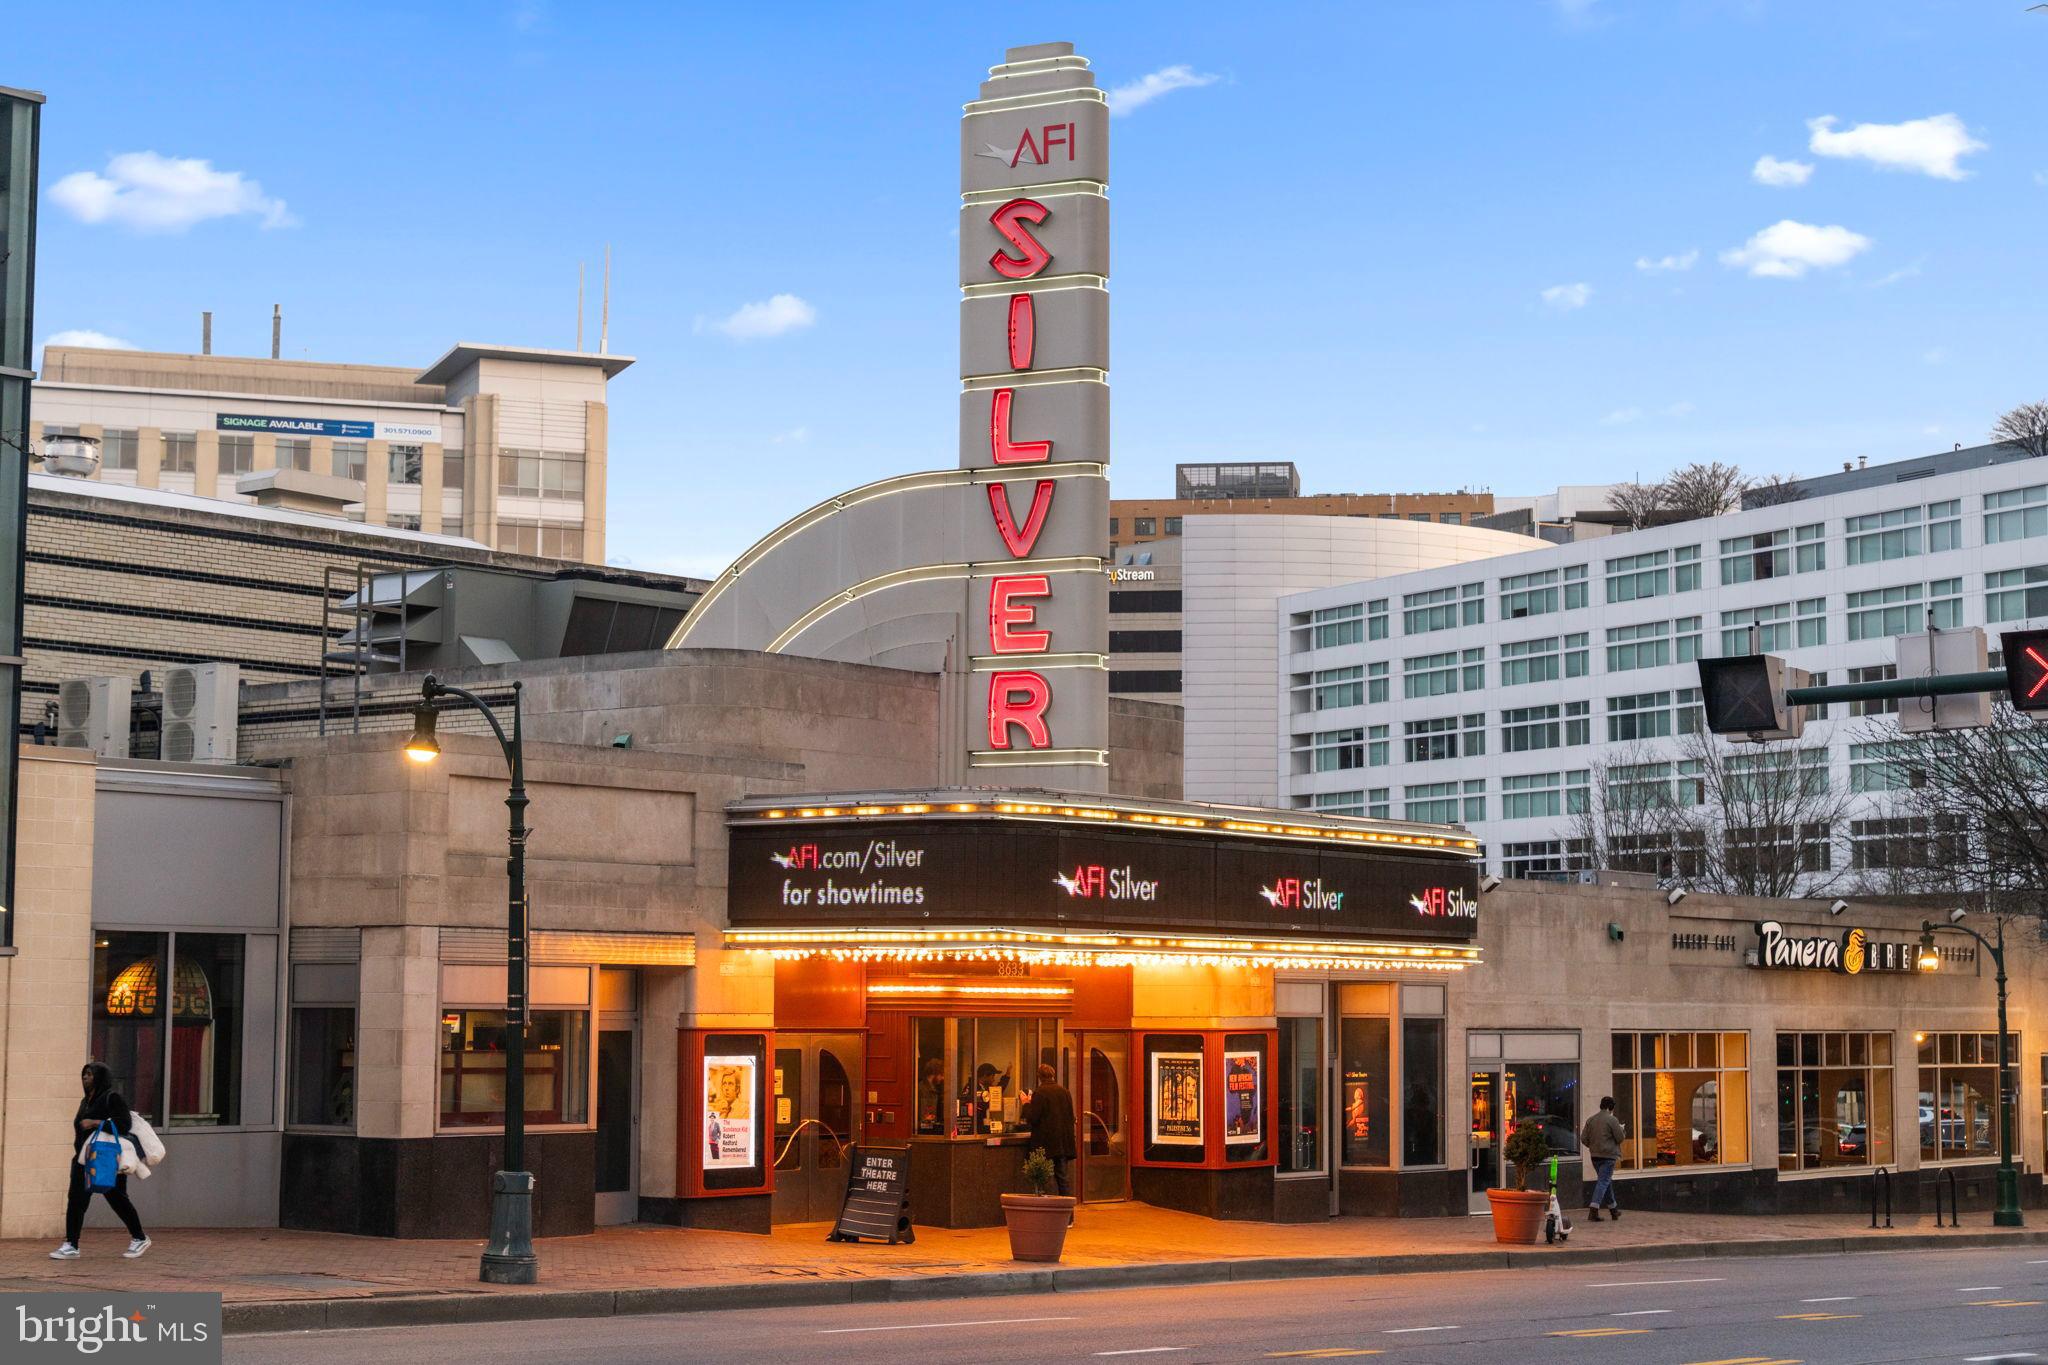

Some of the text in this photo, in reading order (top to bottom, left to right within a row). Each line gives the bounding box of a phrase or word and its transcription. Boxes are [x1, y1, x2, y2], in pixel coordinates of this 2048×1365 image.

[1011, 122, 1076, 169] AFI
[223, 417, 324, 431] SIGNAGE AVAILABLE
[383, 427, 432, 435] 301.571.0900
[987, 198, 1057, 750] SILVER
[786, 840, 925, 874] AFI.com/Silver
[783, 878, 925, 906] for showtimes
[1072, 865, 1158, 901] AFI Silver
[1273, 878, 1343, 911] AFI Silver
[1421, 887, 1478, 919] AFI Silver
[1761, 922, 1838, 967] Panera
[861, 1167, 897, 1180] THEATRE
[866, 1157, 893, 1168] ENTER
[866, 1181, 888, 1191] HERE
